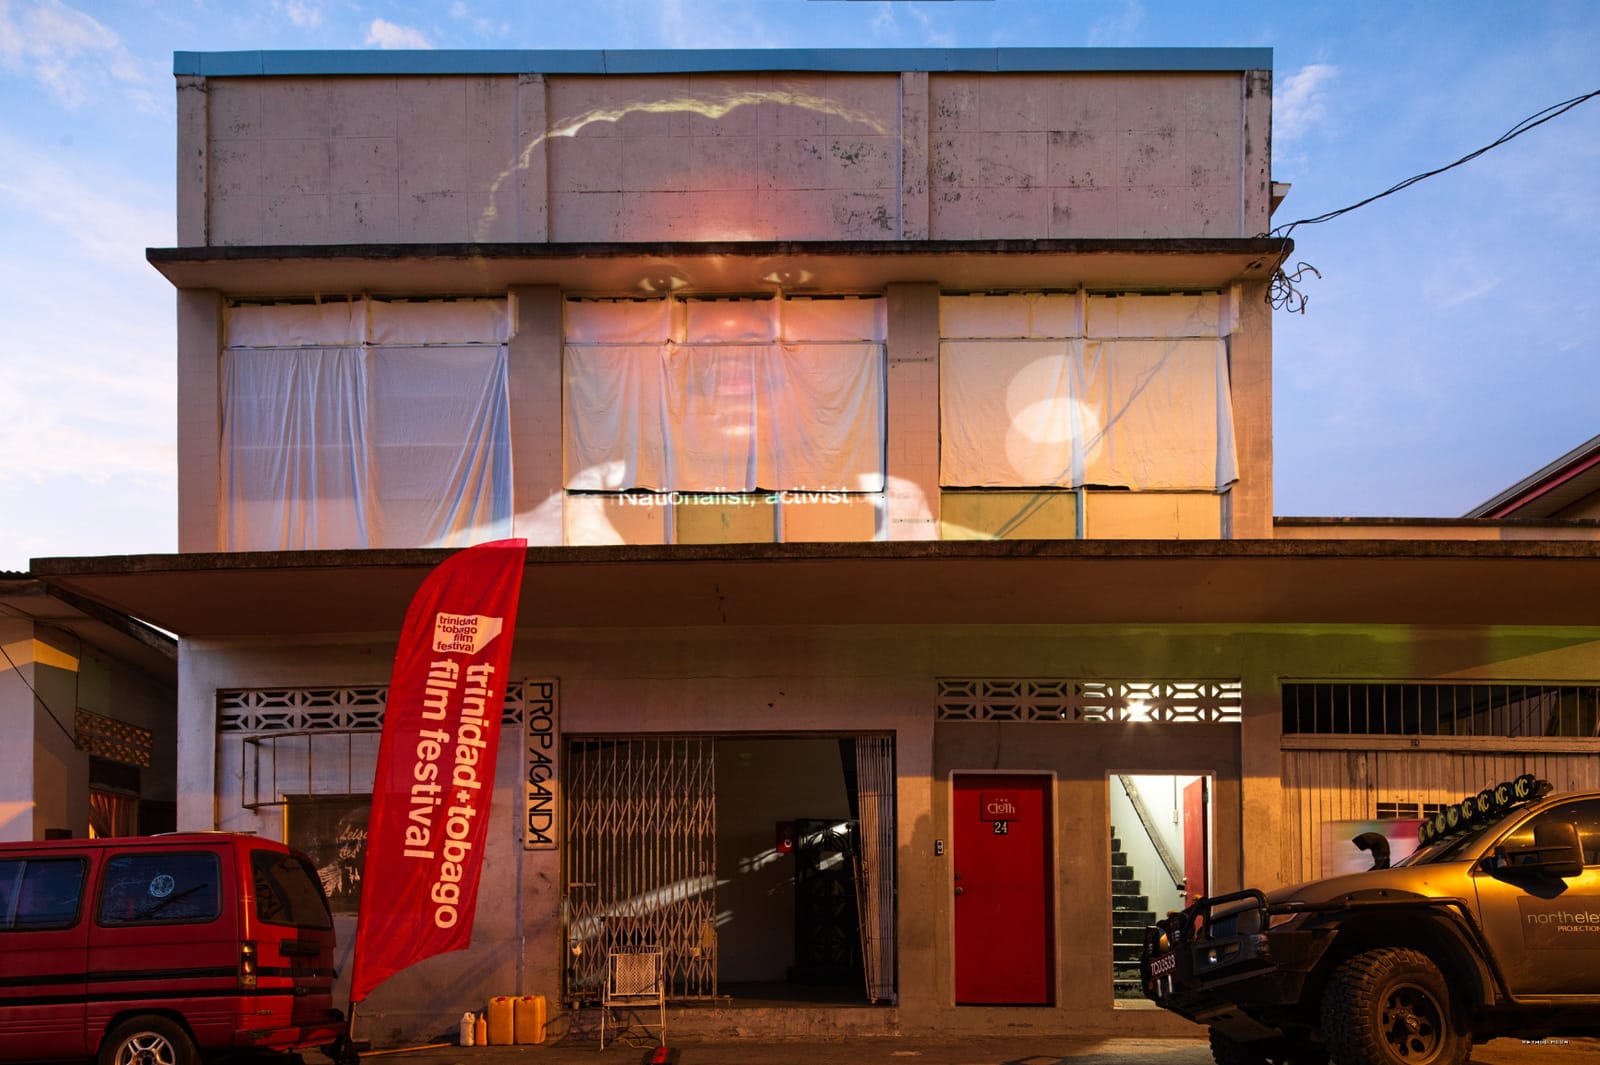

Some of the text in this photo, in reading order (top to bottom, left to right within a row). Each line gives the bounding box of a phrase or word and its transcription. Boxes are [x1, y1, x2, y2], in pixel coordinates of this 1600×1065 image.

[618, 486, 755, 508] Nationalist,
[764, 485, 850, 505] activist
[439, 615, 478, 626] trinidad
[453, 633, 473, 643] film
[437, 641, 475, 652] festival
[403, 658, 460, 859] film festival
[1495, 786, 1509, 805] KC
[1515, 779, 1529, 798] KC
[1477, 794, 1489, 812] KC
[994, 821, 1008, 833] 24
[1527, 911, 1600, 924] northele
